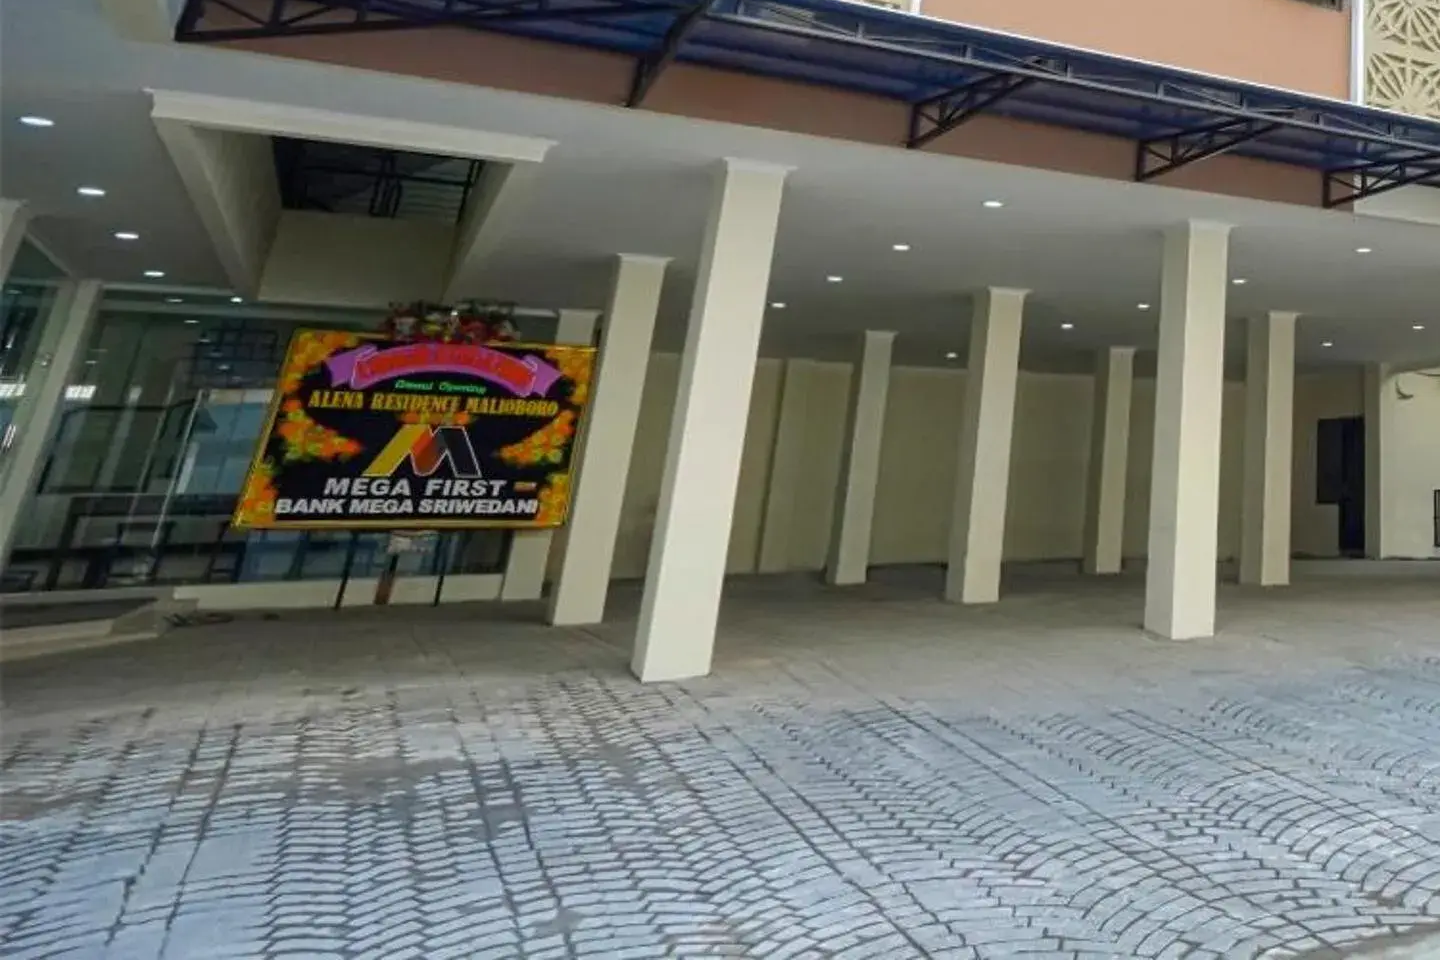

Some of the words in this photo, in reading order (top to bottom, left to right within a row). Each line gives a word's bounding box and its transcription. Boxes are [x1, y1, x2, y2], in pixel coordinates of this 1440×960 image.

[308, 390, 363, 409] ALENA
[371, 392, 460, 413] RESIDENCE
[465, 396, 559, 416] MALIOBORO
[324, 477, 411, 496] MEGA
[424, 478, 506, 497] FIRST
[275, 498, 345, 514] BANK
[348, 498, 414, 514] MEGA
[417, 498, 538, 514] SRIWEDANI
